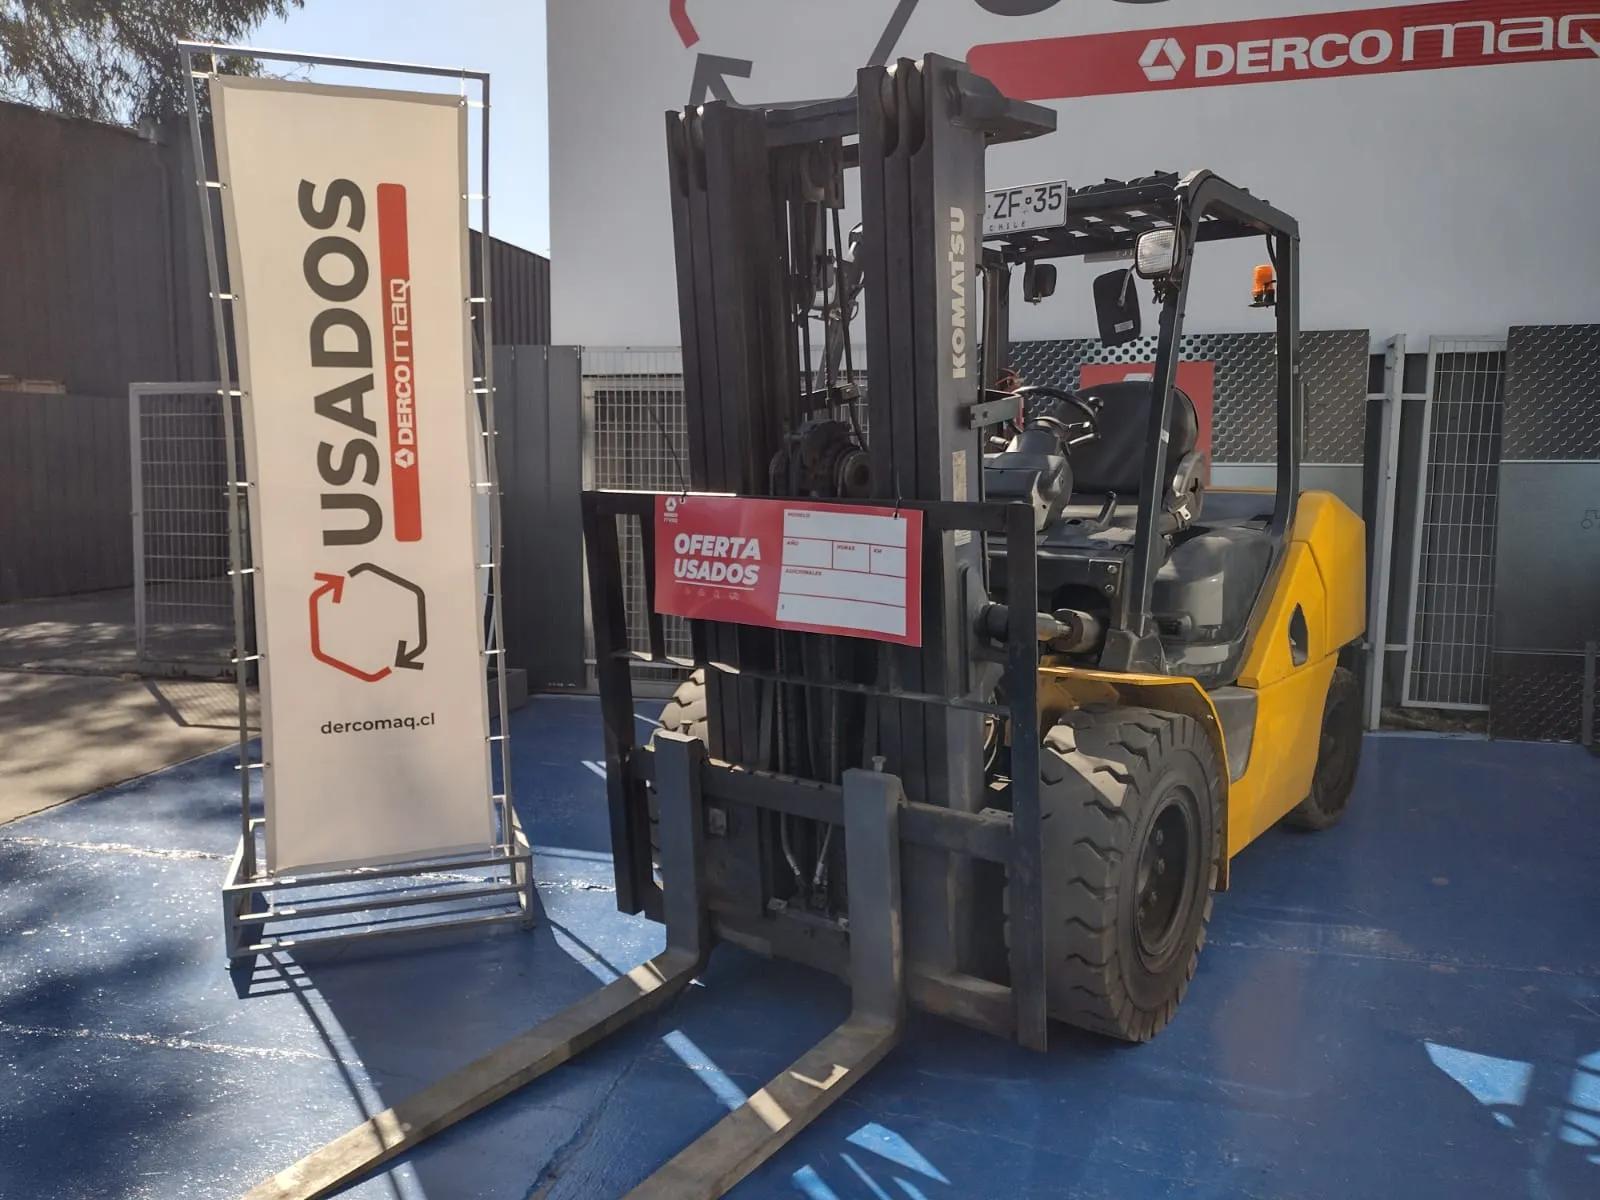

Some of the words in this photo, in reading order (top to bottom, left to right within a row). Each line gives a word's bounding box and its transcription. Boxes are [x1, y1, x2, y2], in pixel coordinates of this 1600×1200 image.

[948, 206, 966, 379] KOMATSU
[297, 178, 383, 546] USADOS
[674, 533, 761, 560] OFERTA
[674, 558, 760, 585] USADOS
[320, 712, 435, 734] dercomaq.cl
